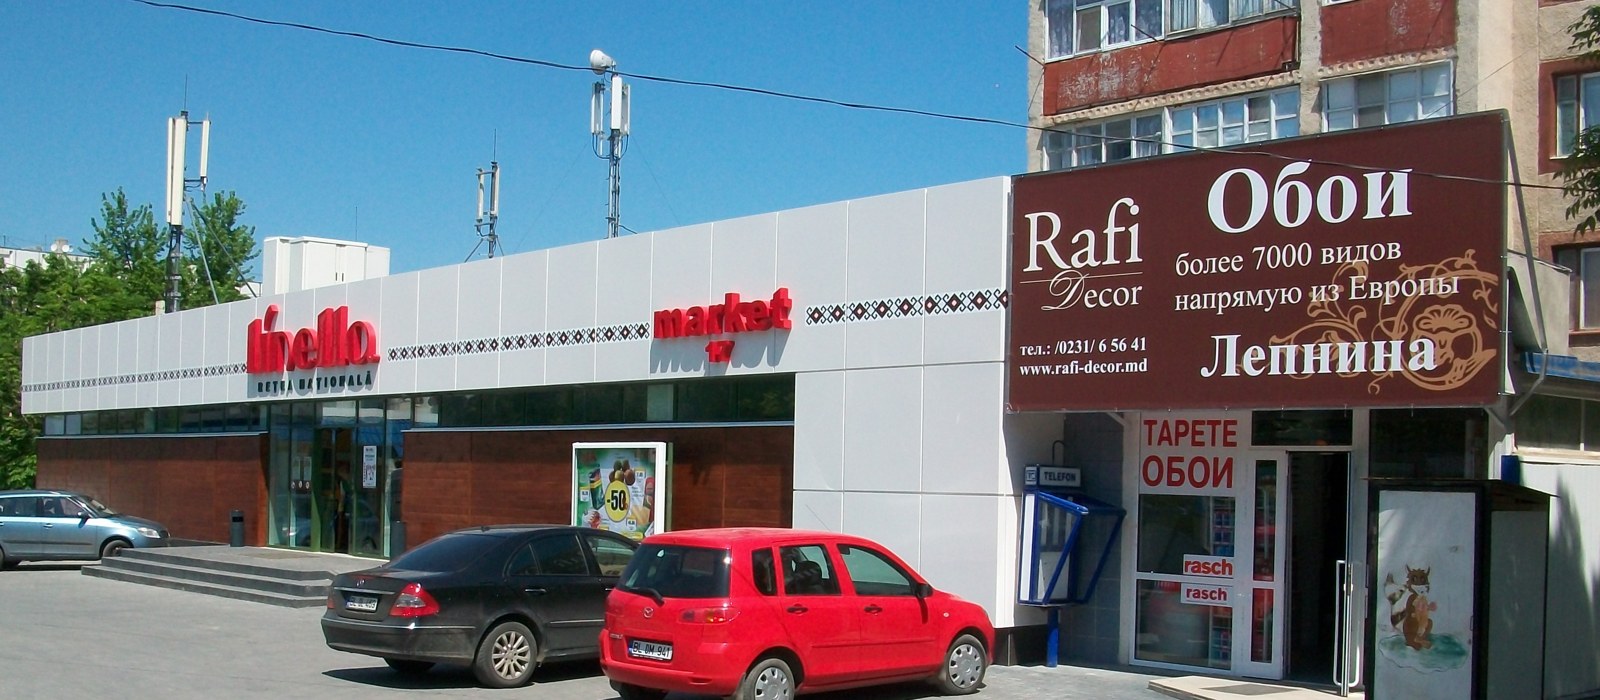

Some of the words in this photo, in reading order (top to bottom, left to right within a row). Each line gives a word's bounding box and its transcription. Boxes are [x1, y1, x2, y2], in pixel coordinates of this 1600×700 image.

[1207, 159, 1413, 233] Обои
[1023, 197, 1143, 272] Rafi
[1175, 252, 1244, 276] более
[1252, 242, 1312, 270] 7000
[1321, 241, 1402, 265] видов
[1041, 269, 1142, 310] Decor
[1175, 285, 1302, 315] напрямую
[1311, 284, 1340, 302] из
[1349, 274, 1459, 304] Европы
[654, 287, 792, 338] market
[705, 340, 735, 363] 17
[1020, 344, 1051, 356] тел.:
[1055, 338, 1095, 354] /0231/
[1099, 338, 1107, 353] 6
[1111, 337, 1128, 352] 56
[1131, 336, 1146, 351] 41
[1200, 334, 1438, 378] Лепнина
[1020, 358, 1148, 376] www.rafi-decor.md
[1143, 419, 1238, 447] TAPETE
[1044, 471, 1076, 482] TELEFON
[1142, 455, 1234, 488] ОБОИ
[1184, 559, 1233, 576] rasch
[1186, 588, 1227, 601] rasch
[633, 642, 642, 653] BL
[657, 644, 670, 657] 941
